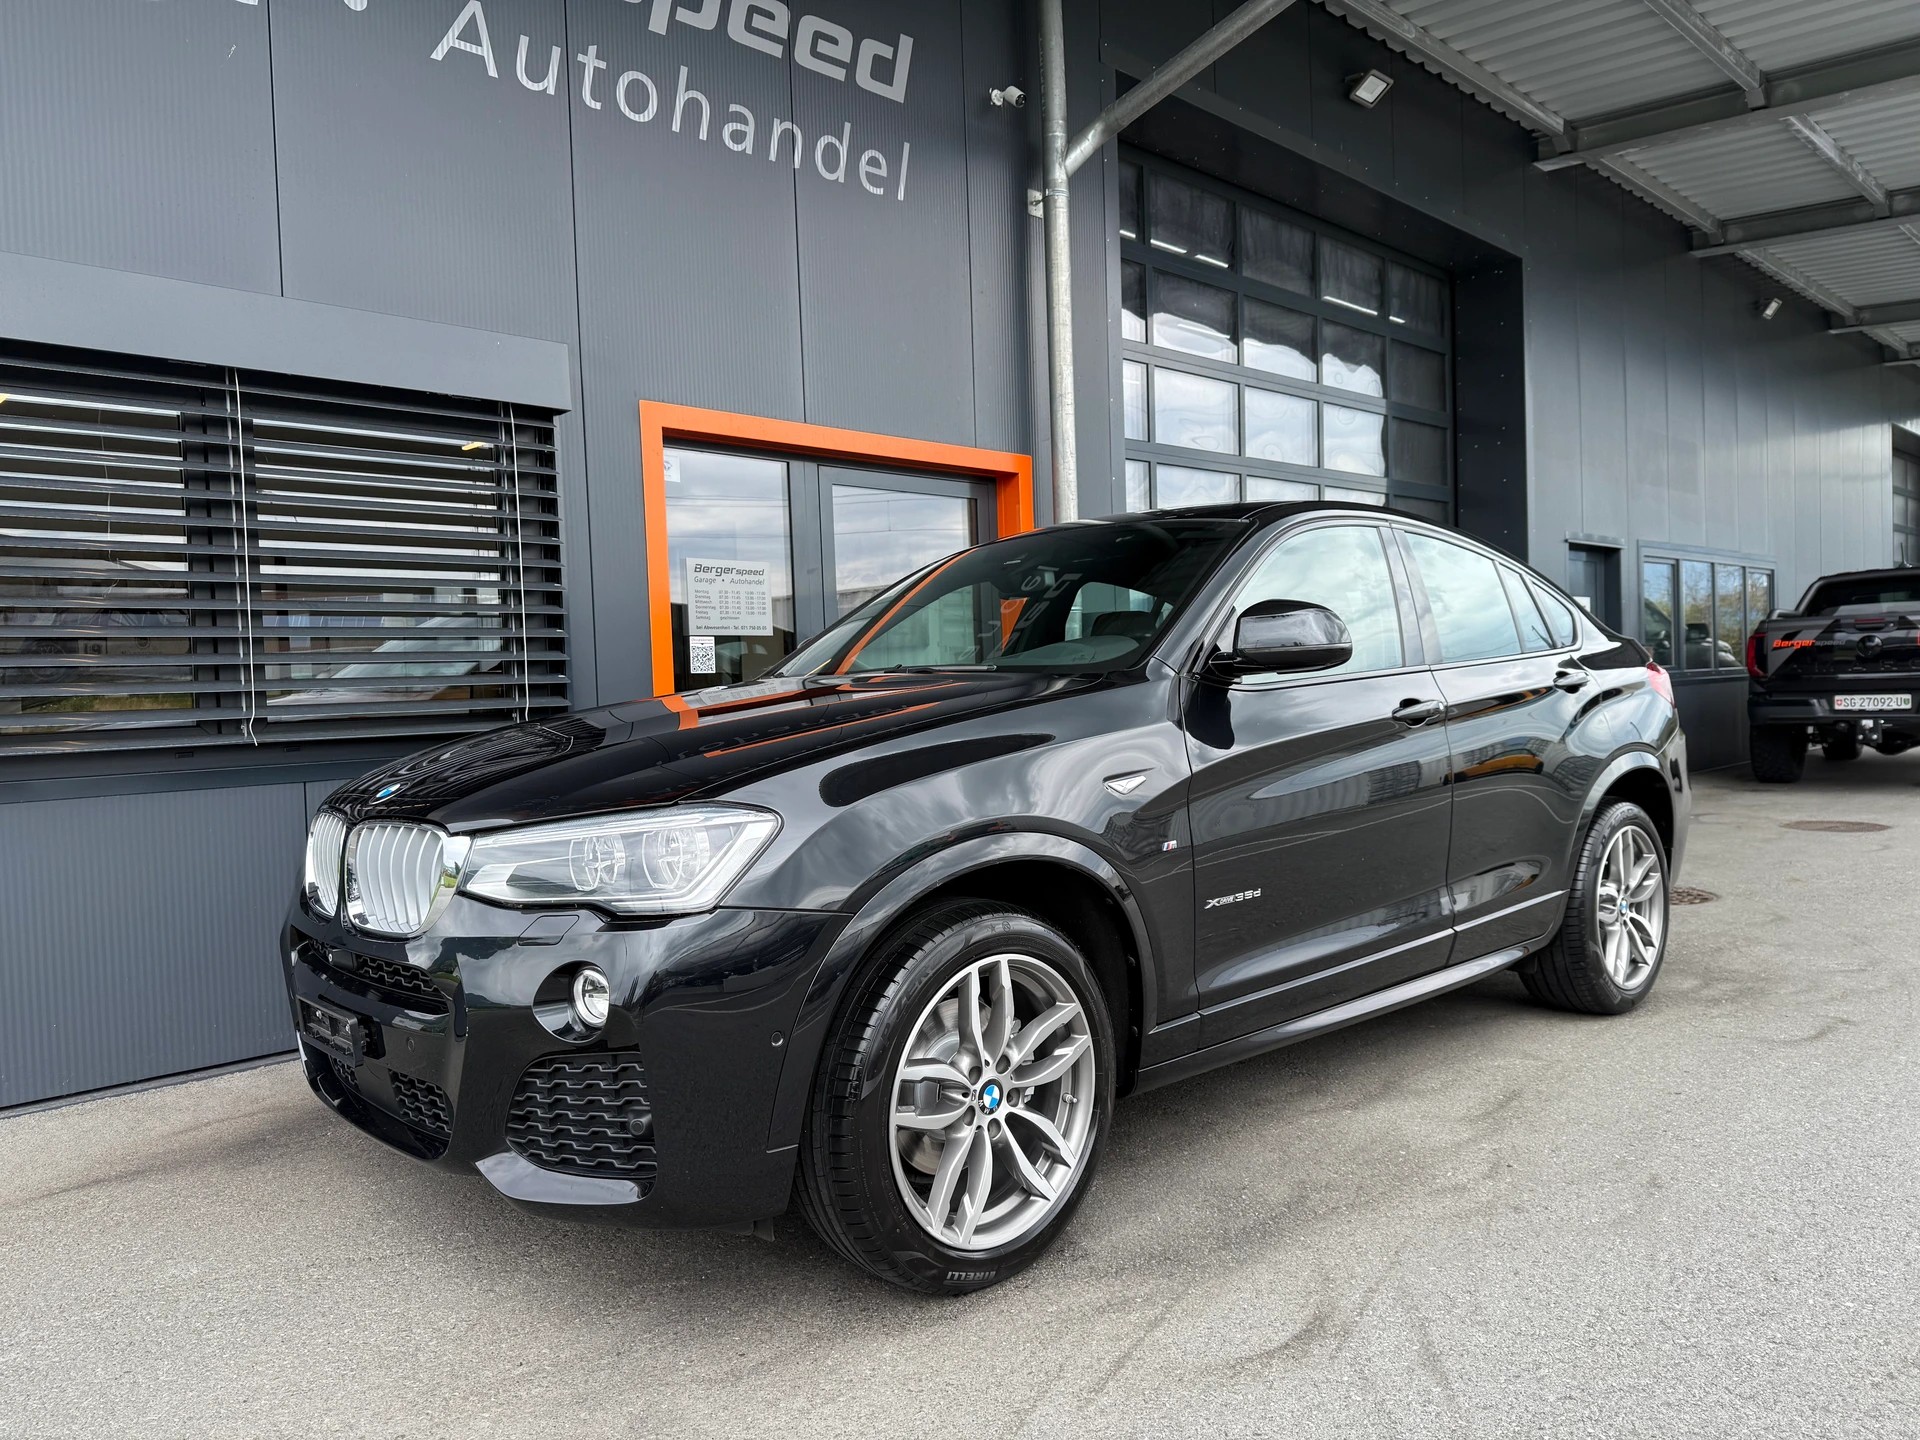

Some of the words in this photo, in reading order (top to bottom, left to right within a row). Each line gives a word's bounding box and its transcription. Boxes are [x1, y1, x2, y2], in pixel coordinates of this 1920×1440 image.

[624, 0, 914, 103] peed
[430, 0, 910, 201] Autohandel
[694, 563, 765, 577] Bergerspeed
[694, 576, 717, 585] Garage
[729, 577, 765, 585] Autohandel
[1843, 697, 1857, 708] SG
[1859, 697, 1893, 708] 27092
[946, 1271, 997, 1281] PIRELLI
